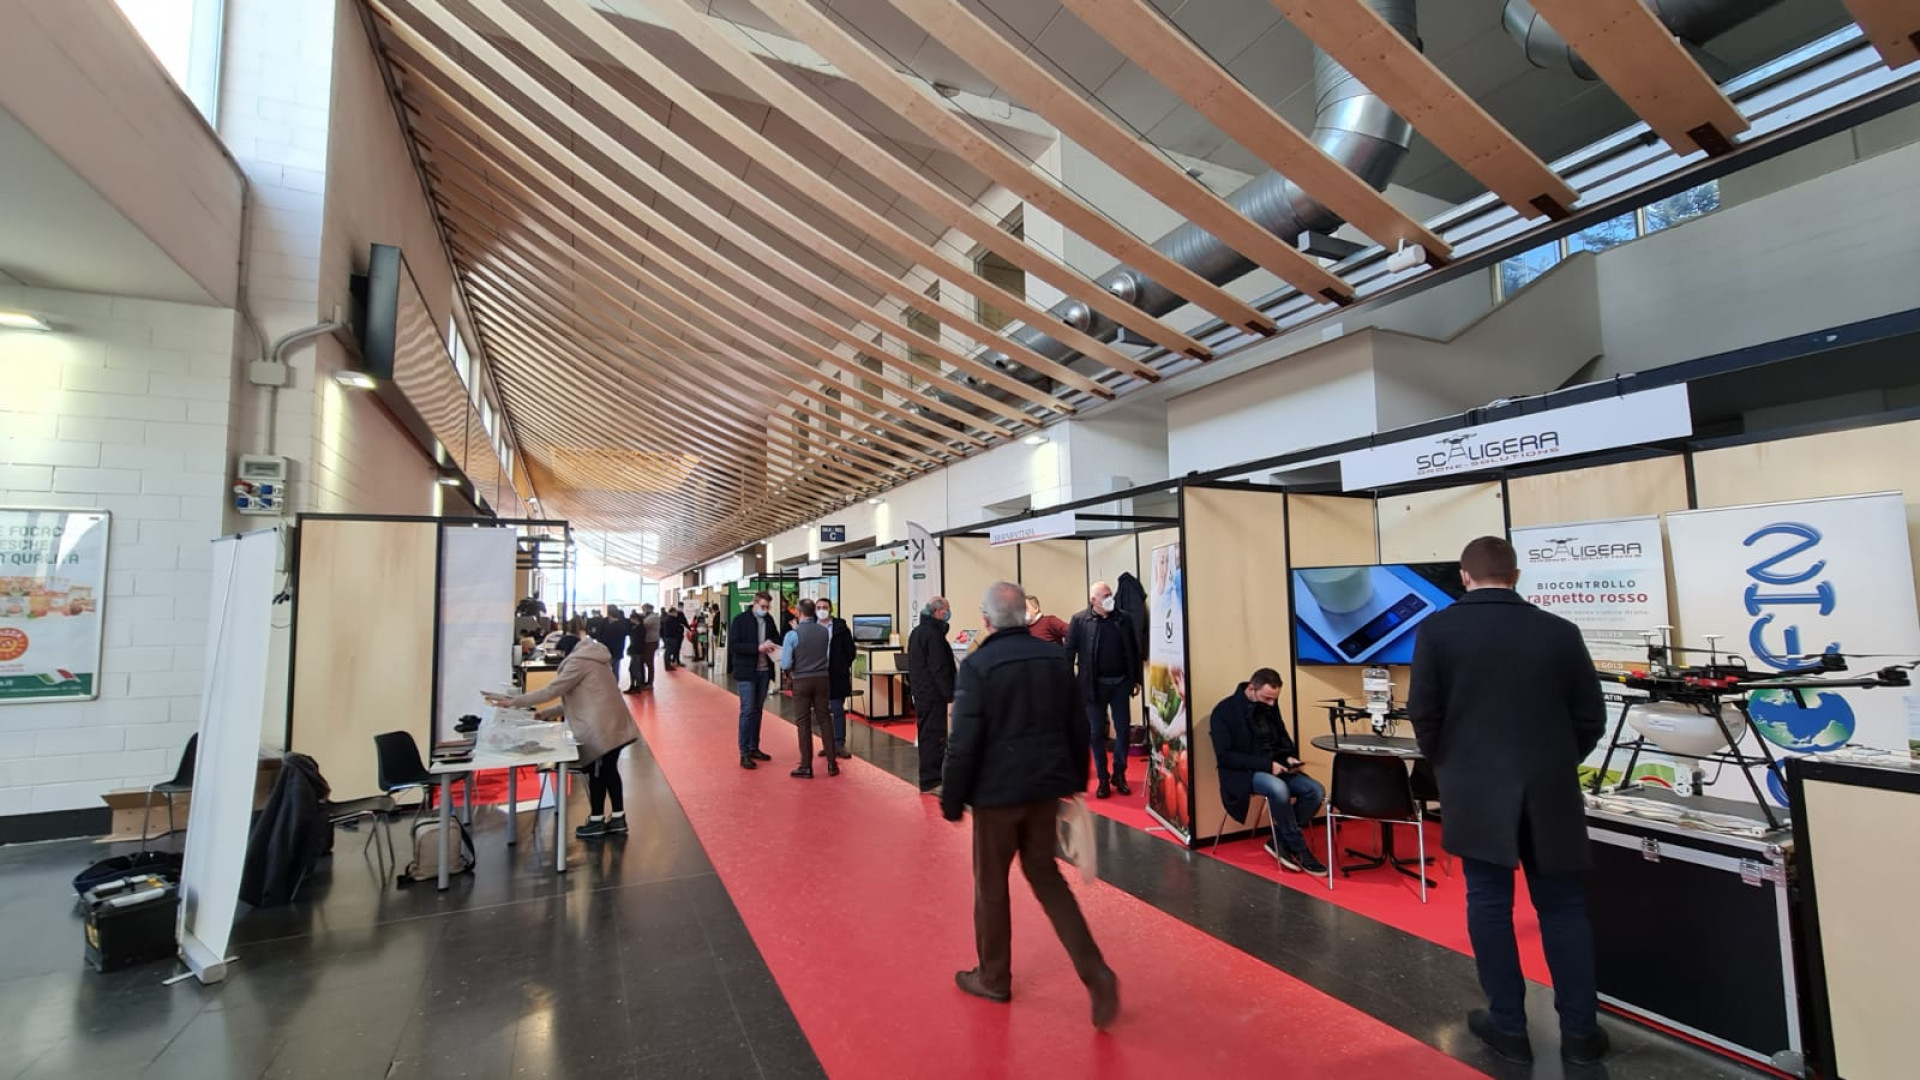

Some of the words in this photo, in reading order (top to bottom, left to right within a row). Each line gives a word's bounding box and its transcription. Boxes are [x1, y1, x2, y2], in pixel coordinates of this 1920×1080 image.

[1416, 431, 1559, 470] SCALIGERA
[1528, 542, 1643, 560] SCALIGERA
[1536, 580, 1636, 590] BIOCONTROLLO
[1526, 592, 1596, 607] ragnetto
[1600, 593, 1648, 603] rosso
